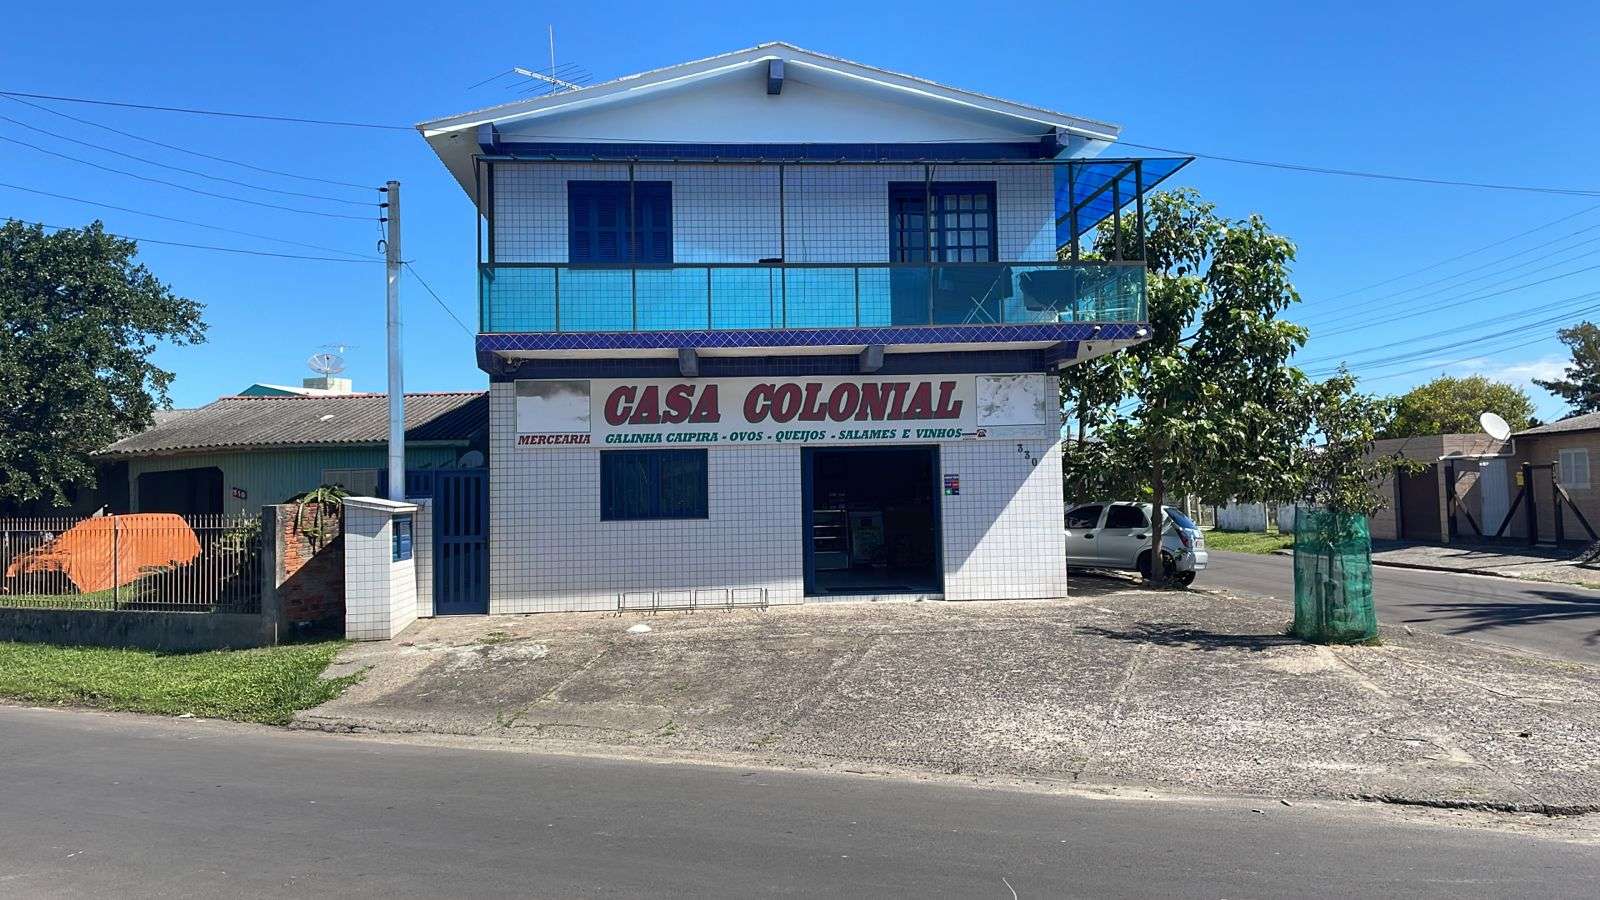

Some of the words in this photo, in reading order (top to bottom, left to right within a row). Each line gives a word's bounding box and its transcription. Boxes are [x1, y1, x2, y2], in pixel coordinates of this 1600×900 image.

[604, 384, 720, 426] CASA
[743, 381, 963, 423] COLONIAL
[518, 434, 590, 445] MERCEARIA
[605, 433, 662, 443] GALINHA
[666, 432, 718, 442] CAIPIRA
[729, 431, 763, 441] OVOS
[775, 430, 826, 442] QUEIJOS
[838, 429, 896, 439] SALAMES
[902, 429, 911, 439] E
[916, 428, 963, 438] VINHOS
